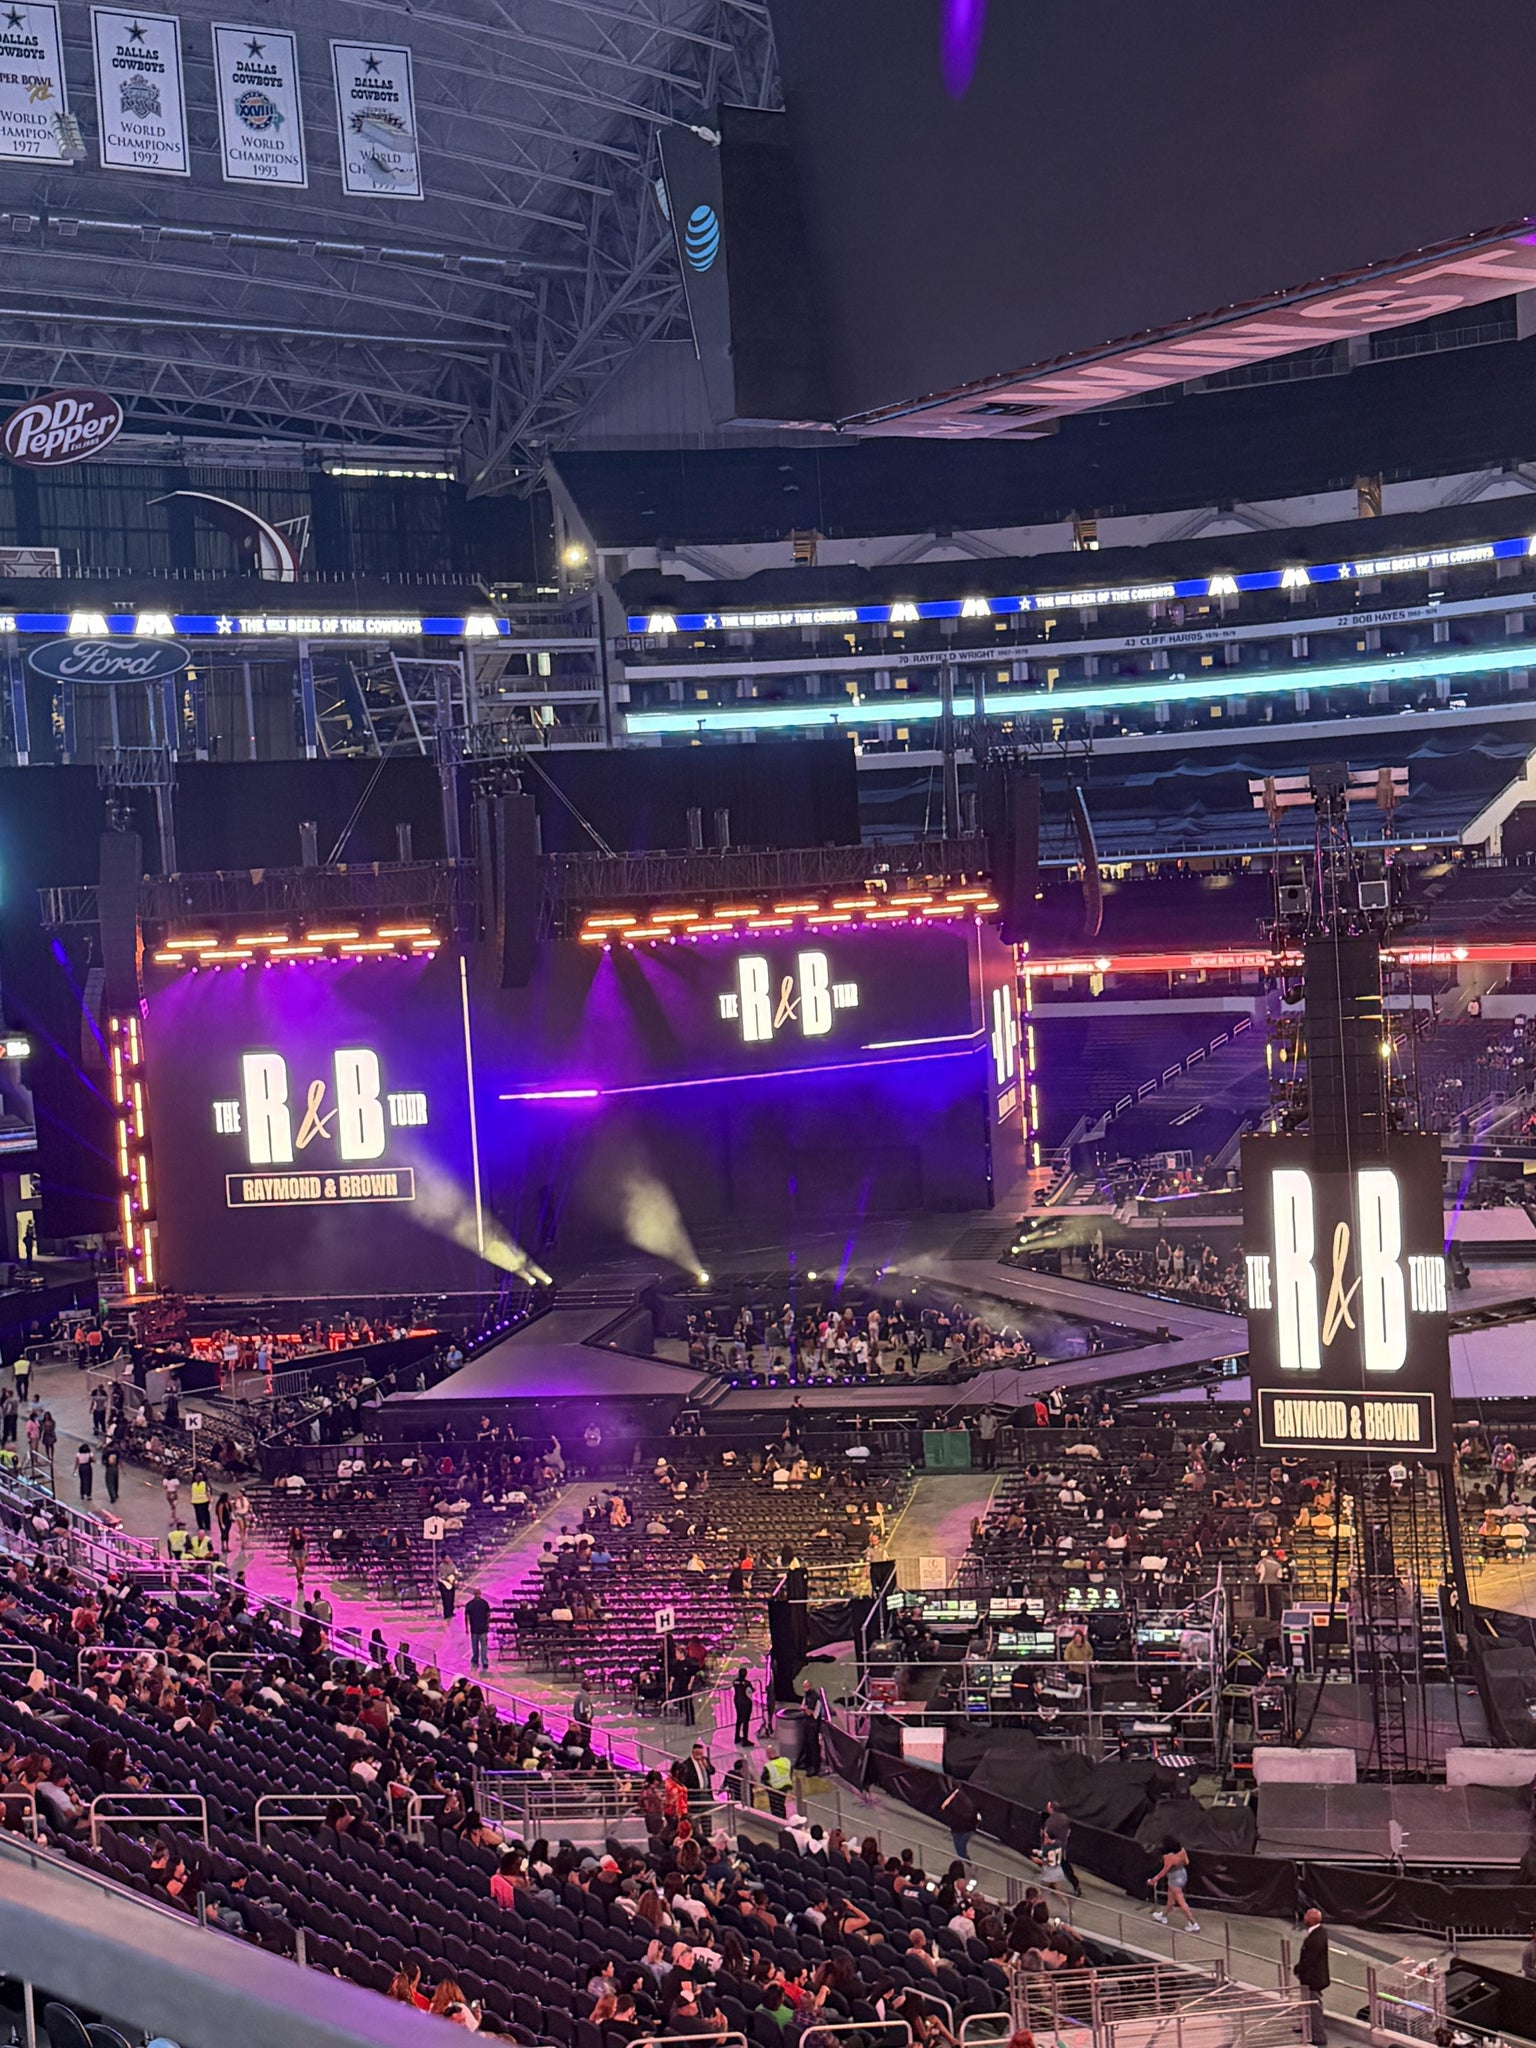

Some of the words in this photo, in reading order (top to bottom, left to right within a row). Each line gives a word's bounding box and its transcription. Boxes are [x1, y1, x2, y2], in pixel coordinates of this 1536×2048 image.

[0, 33, 39, 46] ALLAS
[0, 46, 45, 60] OWBOYS
[116, 46, 159, 60] DALLAS
[112, 58, 165, 73] COWBOYS
[236, 61, 277, 75] DALLAS
[0, 73, 19, 84] PER
[22, 75, 54, 88] BOWL
[232, 73, 283, 88] COWBOYS
[354, 77, 394, 90] DALLAS
[351, 89, 399, 102] COWBOYS
[0, 110, 48, 125] WORLD
[239, 104, 275, 117] XXVIII
[0, 126, 55, 140] HAMPION
[120, 121, 166, 137] WORLD
[13, 141, 41, 153] 1977
[108, 134, 181, 153] CHAMPIONS
[241, 135, 285, 150] WORLD
[133, 151, 159, 164] 1992
[229, 148, 299, 166] CHAMPIONS
[360, 149, 401, 163] WORLD
[253, 164, 279, 177] 1993
[980, 250, 1536, 401] WINST
[50, 398, 94, 430] Dr
[5, 404, 116, 459] Pepper
[239, 618, 266, 633] THE
[323, 618, 339, 633] OF
[340, 618, 365, 633] THE
[365, 619, 422, 634] COWBOYS
[1337, 618, 1348, 626] 22
[1352, 614, 1373, 624] BOB
[1374, 611, 1405, 622] HAYES
[1140, 635, 1167, 646] CLIFF
[1169, 632, 1203, 642] HARRIS
[59, 640, 163, 675] Ford
[958, 650, 995, 660] WRIGHT
[213, 1101, 242, 1134] THE
[387, 1093, 428, 1126] TOUR
[242, 1176, 321, 1202] RAYMOND
[324, 1178, 337, 1198] &
[339, 1173, 398, 1198] BROWN
[1245, 1255, 1272, 1310] THE
[1408, 1256, 1448, 1313] TOUR
[188, 1417, 198, 1427] K
[1273, 1399, 1348, 1440] RAYMOND
[1350, 1405, 1363, 1440] &
[1363, 1401, 1420, 1442] BROWN
[430, 1524, 438, 1535] J
[660, 1613, 670, 1628] H
